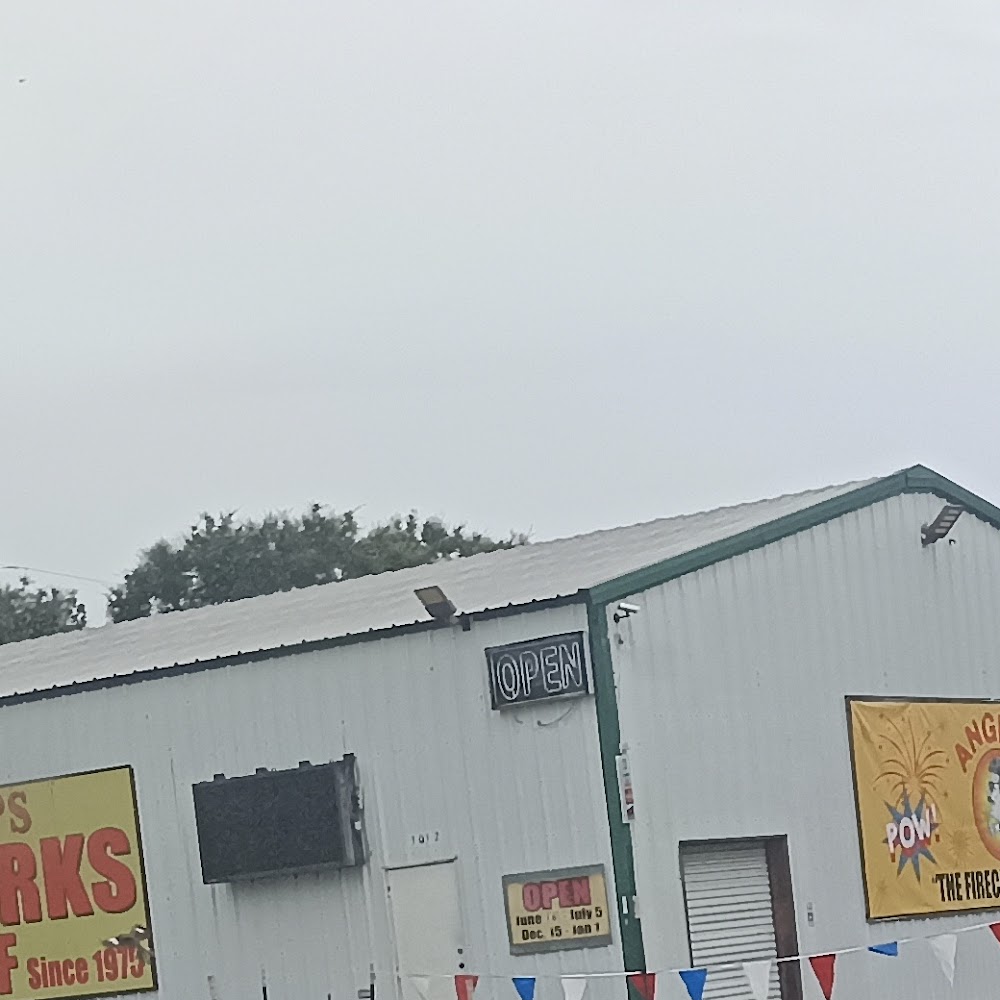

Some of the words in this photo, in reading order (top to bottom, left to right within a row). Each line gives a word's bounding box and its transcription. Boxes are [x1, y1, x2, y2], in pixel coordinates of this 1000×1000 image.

[497, 642, 582, 700] OPEN
[0, 791, 32, 834] S
[522, 876, 592, 913] OPEN
[595, 906, 603, 918] 5
[550, 925, 562, 938] 15
[594, 922, 600, 933] 1
[27, 956, 89, 990] Since
[92, 946, 146, 983] 1975
